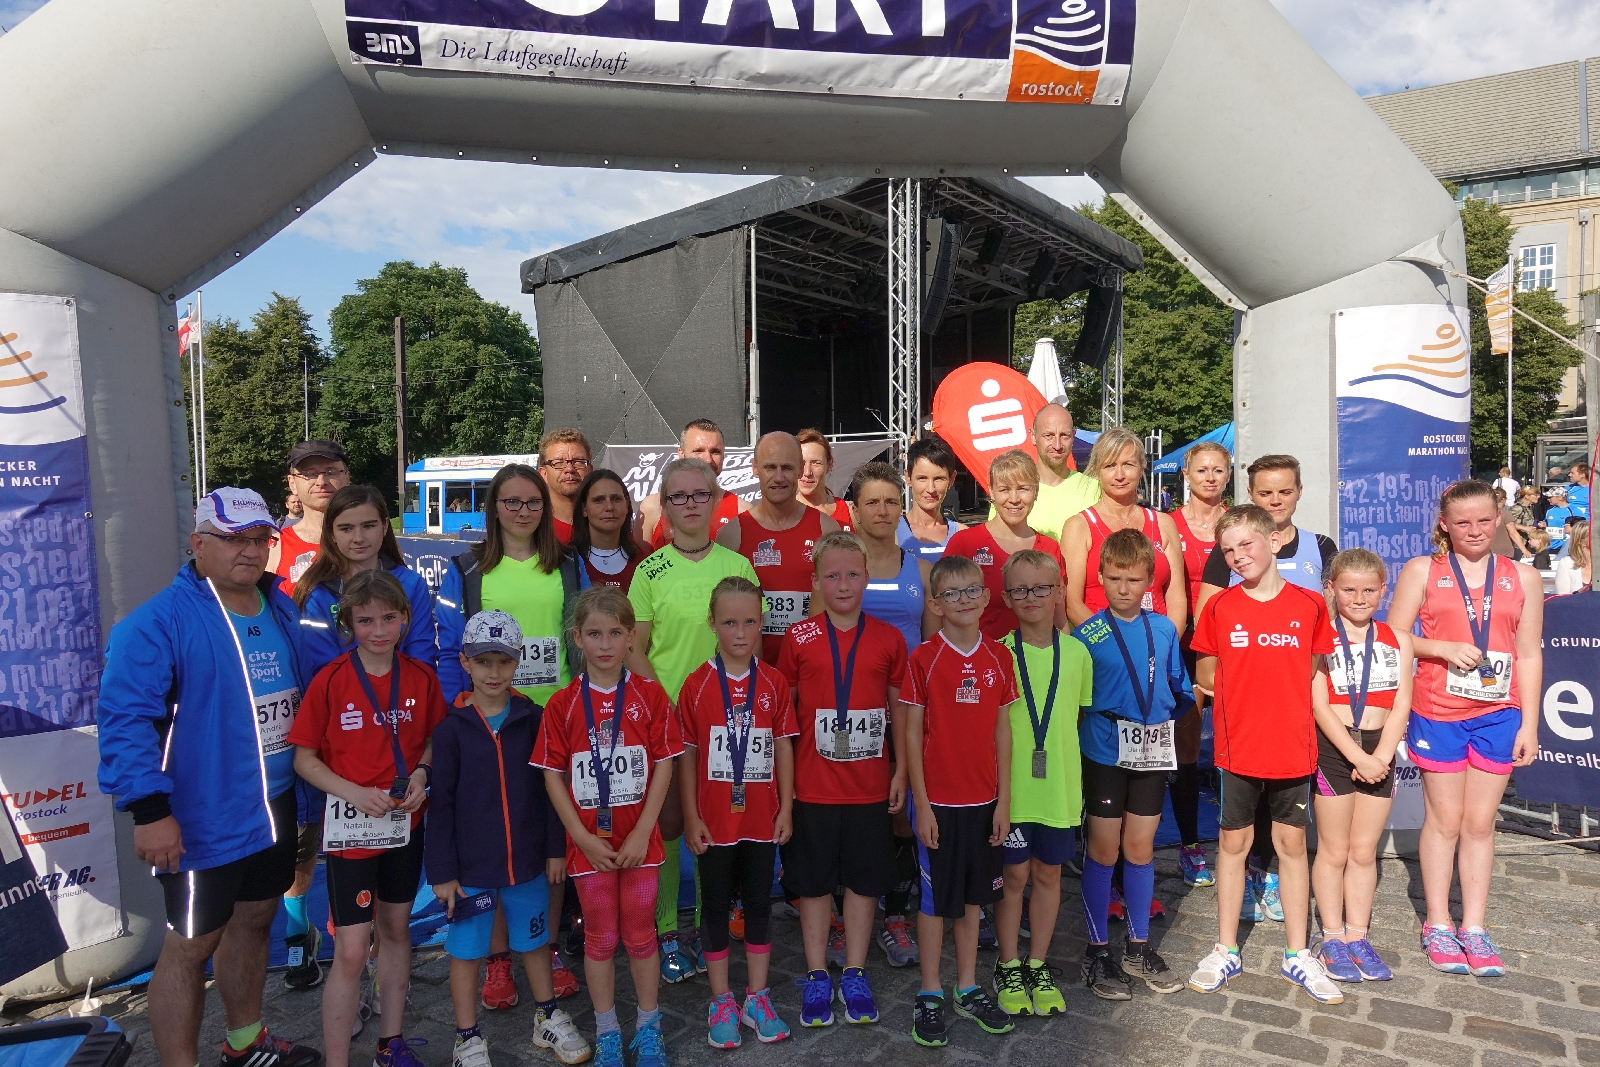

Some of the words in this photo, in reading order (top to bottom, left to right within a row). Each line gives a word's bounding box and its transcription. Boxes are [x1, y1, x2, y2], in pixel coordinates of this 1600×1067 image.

[440, 38, 477, 60] Die
[484, 41, 630, 75] Laufgesellschaft
[1020, 80, 1084, 98] rostock
[1423, 434, 1467, 444] ROSTOCKER
[1408, 446, 1455, 456] MARATHON
[11, 475, 61, 487] NACHT
[1344, 500, 1421, 525] marathon
[247, 625, 262, 637] AS
[1257, 633, 1300, 648] OSPA
[256, 698, 291, 725] 573
[14, 803, 68, 822] Rostock
[343, 821, 373, 830] Natalia
[28, 827, 69, 843] bequem
